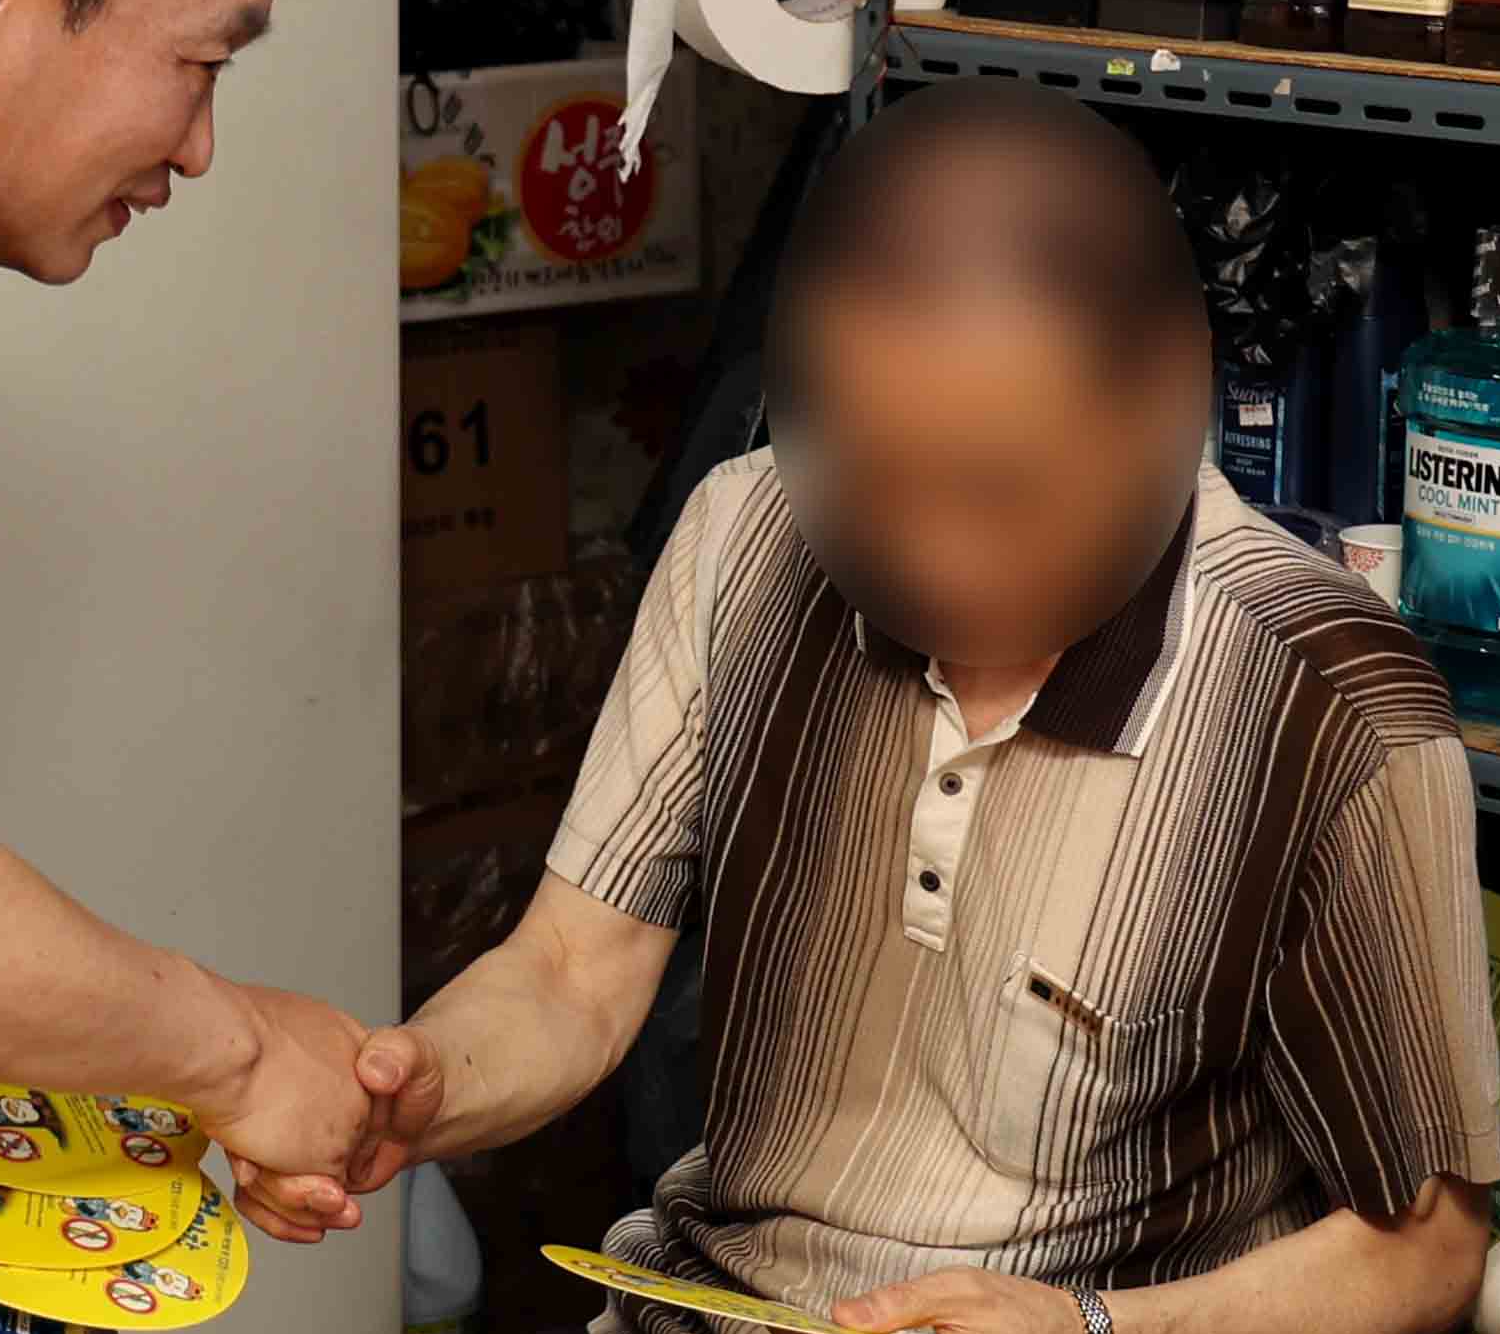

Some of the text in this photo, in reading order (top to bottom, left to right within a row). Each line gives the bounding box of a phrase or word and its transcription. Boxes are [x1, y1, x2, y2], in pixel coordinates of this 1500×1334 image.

[408, 396, 491, 478] 61
[1418, 484, 1500, 517] COOL MINT
